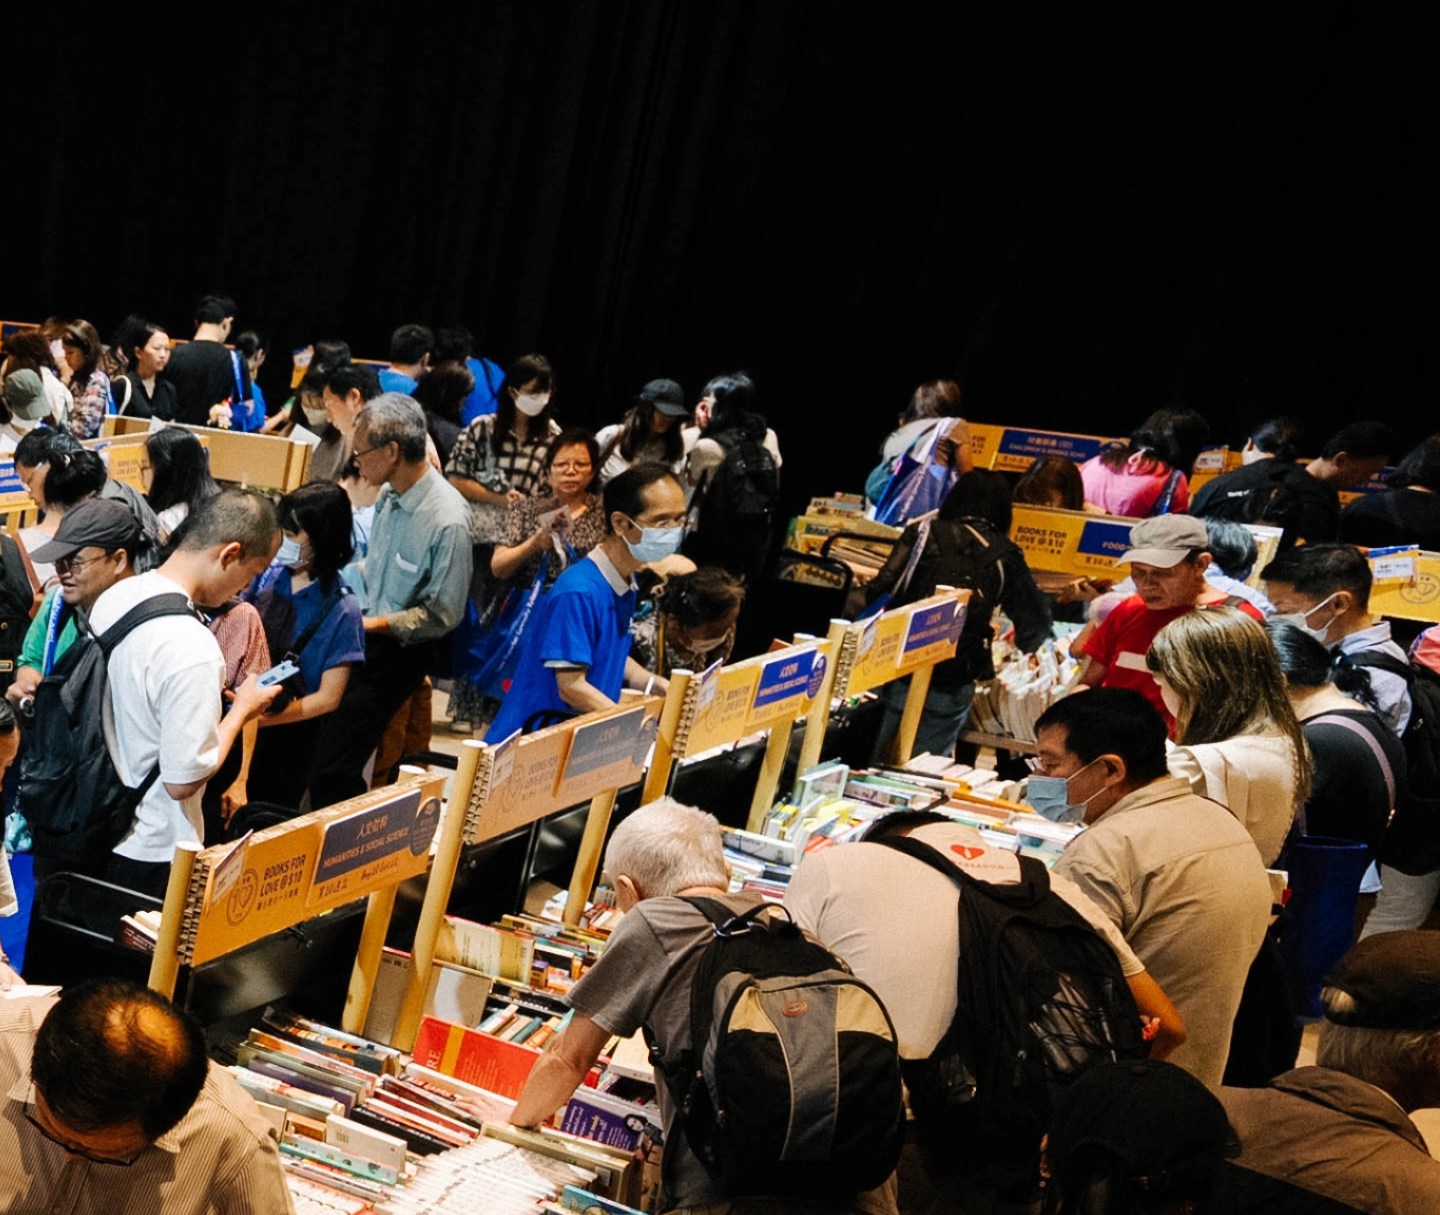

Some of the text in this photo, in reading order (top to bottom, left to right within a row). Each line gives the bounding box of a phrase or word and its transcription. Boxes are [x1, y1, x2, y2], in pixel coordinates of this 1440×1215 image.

[1017, 525, 1067, 540] BOOKS FOR
[264, 853, 306, 881] BOOKS FOR
[259, 869, 303, 898] LOVE @ $10
